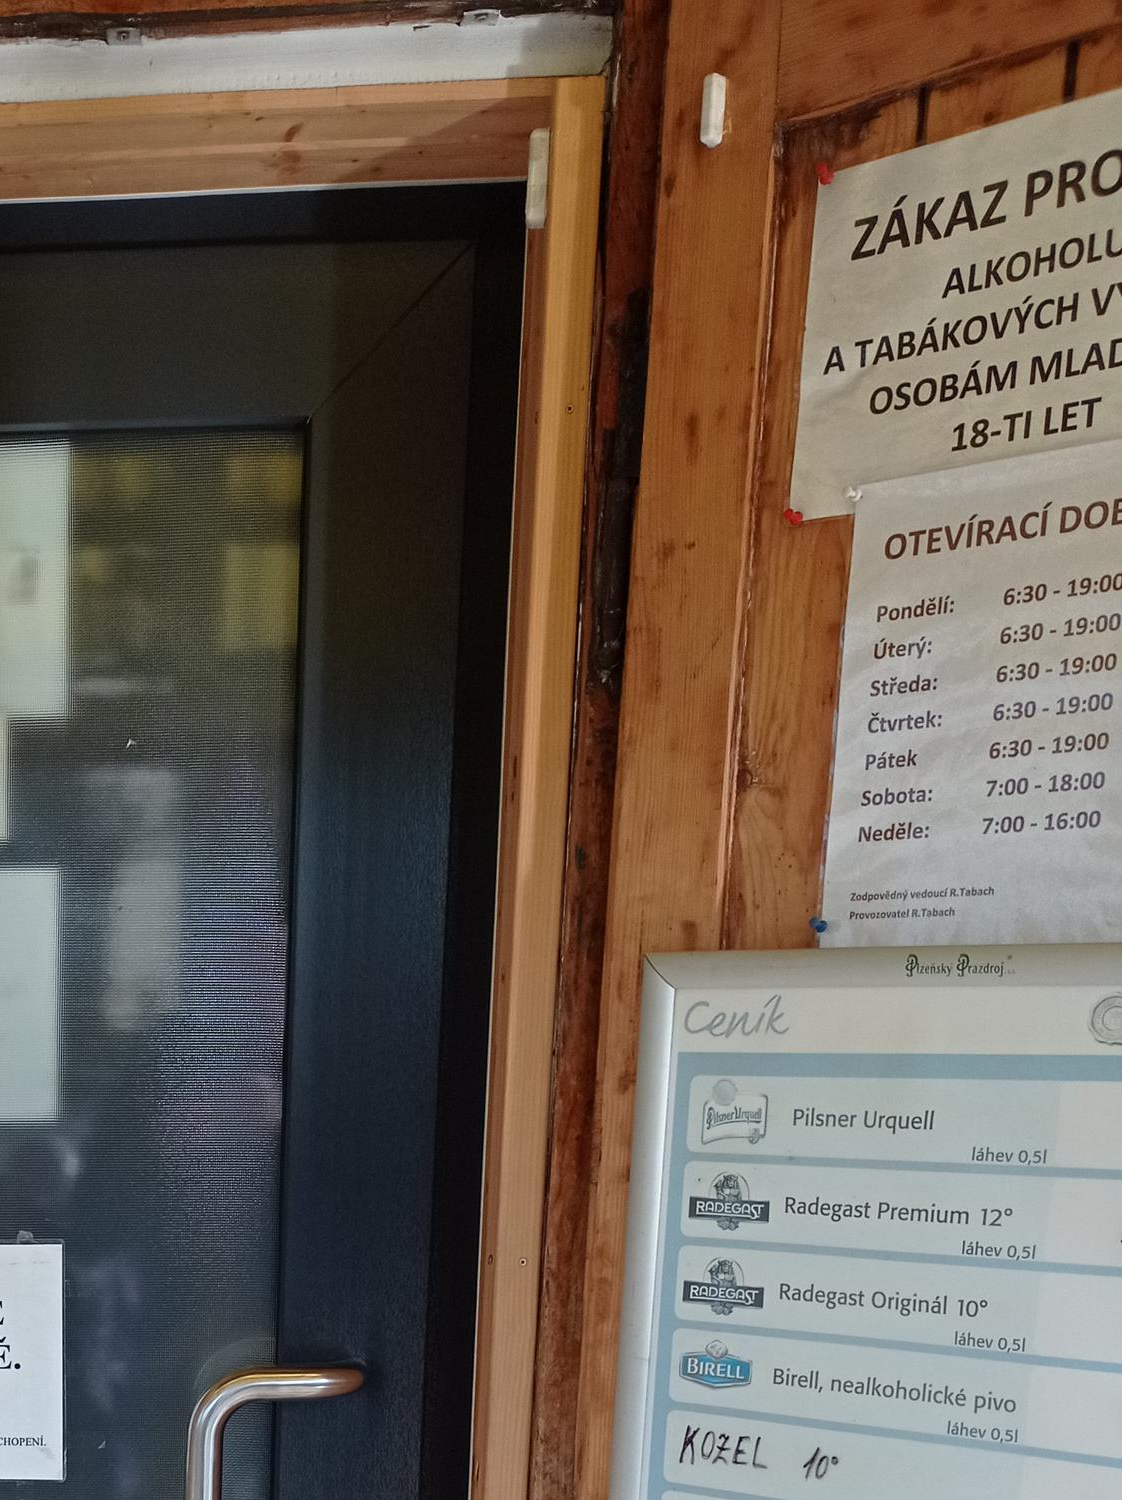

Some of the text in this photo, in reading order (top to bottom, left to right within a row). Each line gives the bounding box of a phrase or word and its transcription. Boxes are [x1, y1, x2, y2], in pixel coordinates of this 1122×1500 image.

[851, 180, 1009, 260] ZÁKAZ
[823, 281, 1122, 375] A TABÁKOVÝCH V
[869, 360, 1018, 415] OSOBÁM
[951, 397, 1102, 452] 18-TI LET
[884, 501, 1053, 560] OTEVÍRACÍ
[877, 595, 955, 623] Pondělí:
[1003, 584, 1047, 606] 6:30
[1067, 573, 1122, 597] 19:00
[873, 636, 932, 660] Úterý:
[1000, 623, 1043, 644] 6:30
[1063, 613, 1121, 637] 19:00
[870, 675, 938, 697] Středa:
[996, 662, 1039, 683] 6:30
[1059, 653, 1117, 676] 19:00
[868, 710, 943, 734] Čtvrtek:
[992, 700, 1036, 721] 6:30
[1055, 693, 1114, 716] 19:00
[865, 749, 917, 771] Pátek
[989, 739, 1032, 759] 6:30
[1051, 732, 1110, 754] 19:00
[861, 788, 933, 807] Sobota:
[986, 777, 1029, 797] 7:00
[1048, 771, 1106, 793] 18:00
[858, 822, 930, 843] Neděle:
[982, 816, 1025, 835] 7:00
[1043, 810, 1102, 831] 16:00
[850, 886, 995, 904] Zodpovědný vedoucí R.Tabach
[849, 906, 956, 920] Provozovatel R.Tabach
[905, 954, 952, 978] Plzeňský
[683, 995, 790, 1040] Ceník
[793, 1109, 935, 1135] Pilsner Urquell
[971, 1146, 1047, 1166] láhev 0,5l
[695, 1199, 765, 1219] RADEGAST
[784, 1197, 1013, 1227] Radegast Premium 12°
[961, 1241, 1036, 1261] láhev 0,5l
[689, 1284, 759, 1305] RADEGAST
[778, 1283, 988, 1318] Radegast Originál 10°
[953, 1331, 1026, 1353] láhev 0,5l
[686, 1356, 745, 1381] BIRELL
[773, 1368, 1016, 1414] Birell, nealkoholické pivo
[946, 1420, 1018, 1443] láhev 0,5l
[678, 1424, 839, 1480] KOZEL 10°
